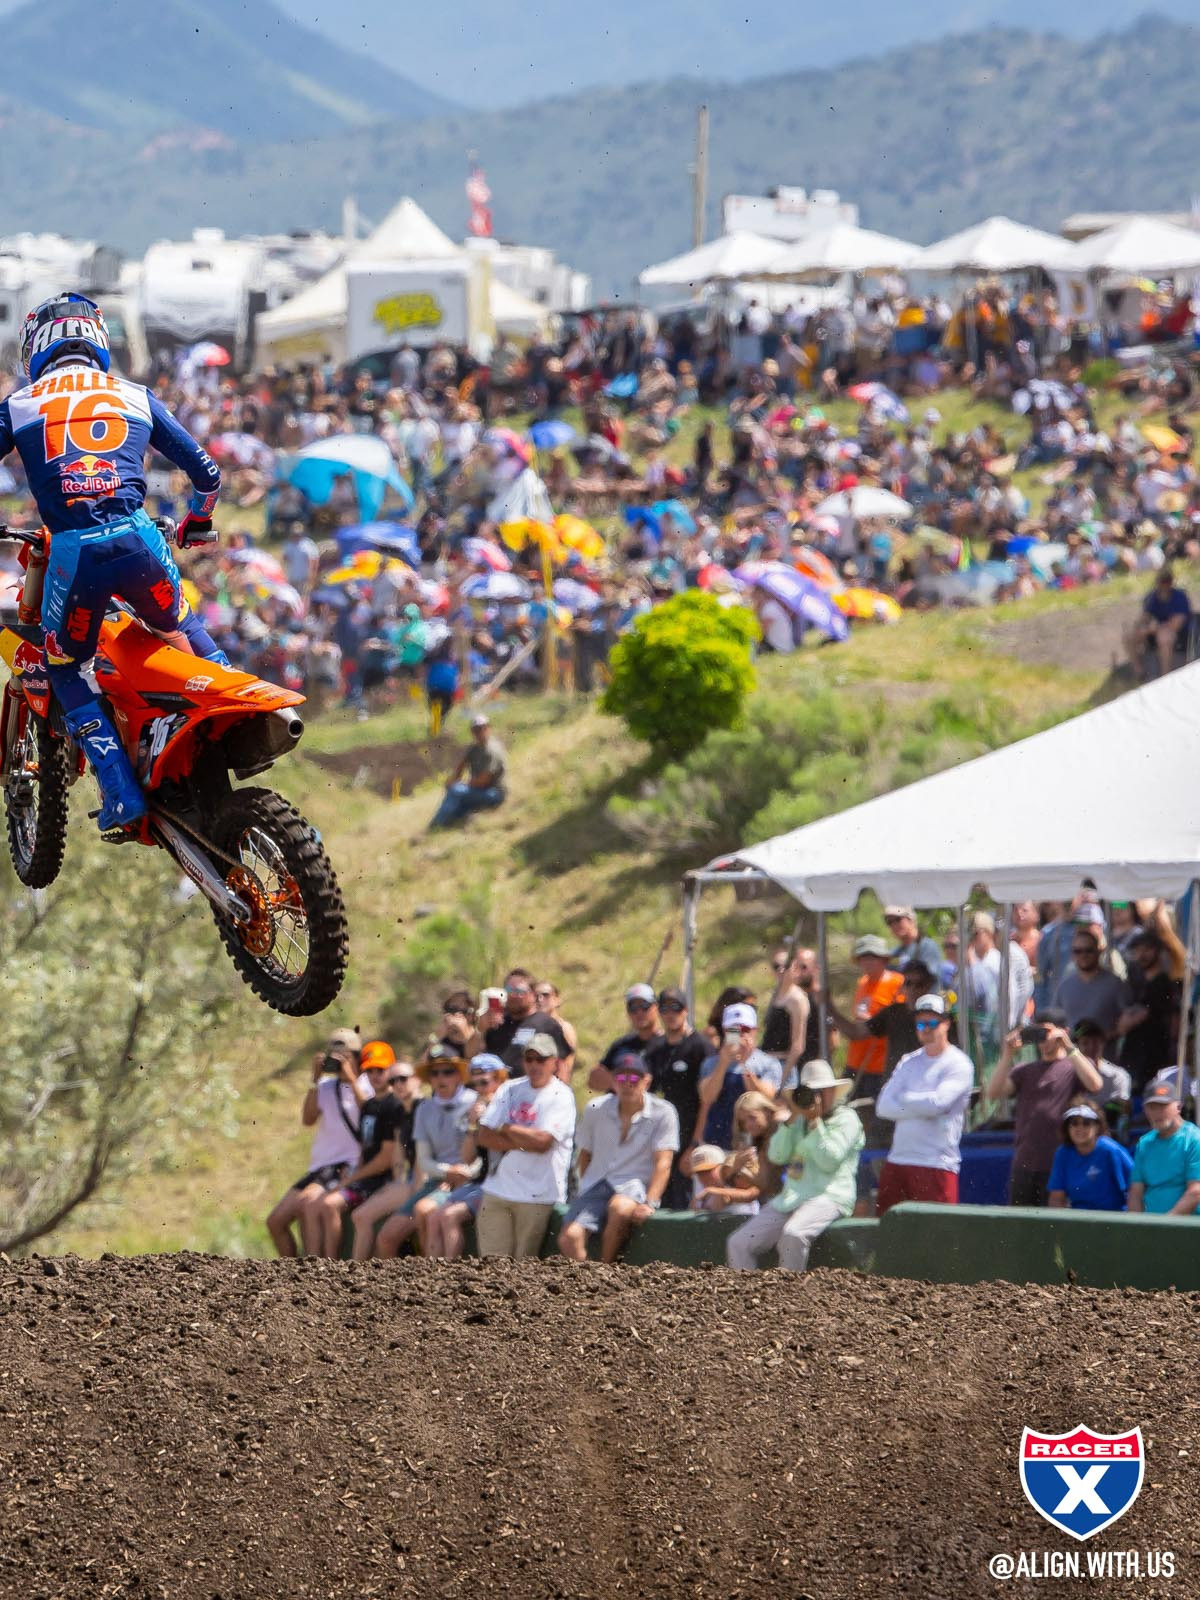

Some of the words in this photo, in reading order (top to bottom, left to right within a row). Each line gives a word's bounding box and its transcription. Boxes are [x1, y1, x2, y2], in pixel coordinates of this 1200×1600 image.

[39, 393, 129, 463] 16
[61, 476, 92, 493] Red
[92, 476, 122, 492] Bull
